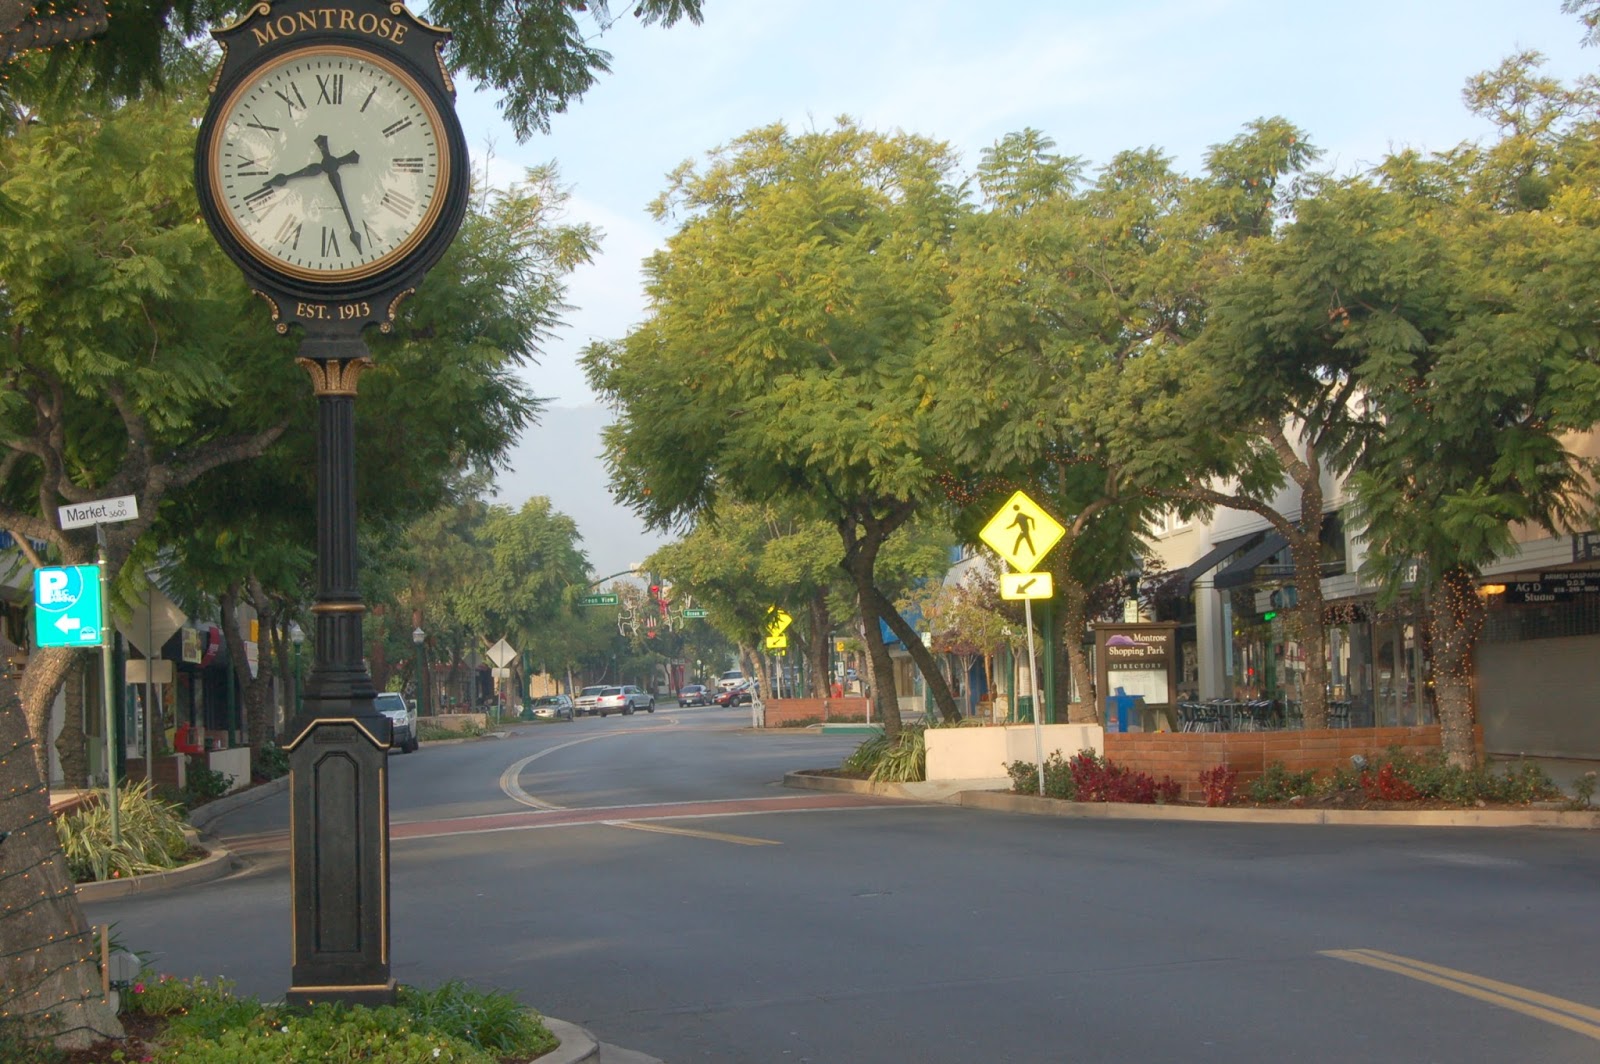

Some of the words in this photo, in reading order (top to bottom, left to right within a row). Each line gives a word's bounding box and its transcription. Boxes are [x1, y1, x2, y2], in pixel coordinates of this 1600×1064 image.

[251, 8, 408, 47] MONTROSE
[296, 302, 331, 320] EST.
[338, 302, 370, 319] 1913
[66, 504, 108, 523] Market
[109, 509, 127, 518] 3600
[1524, 593, 1555, 602] Studio
[1133, 633, 1167, 642] Montrose
[1109, 646, 1144, 657] Shopping
[1147, 645, 1165, 655] Park
[1112, 662, 1162, 670] DIRECTORY
